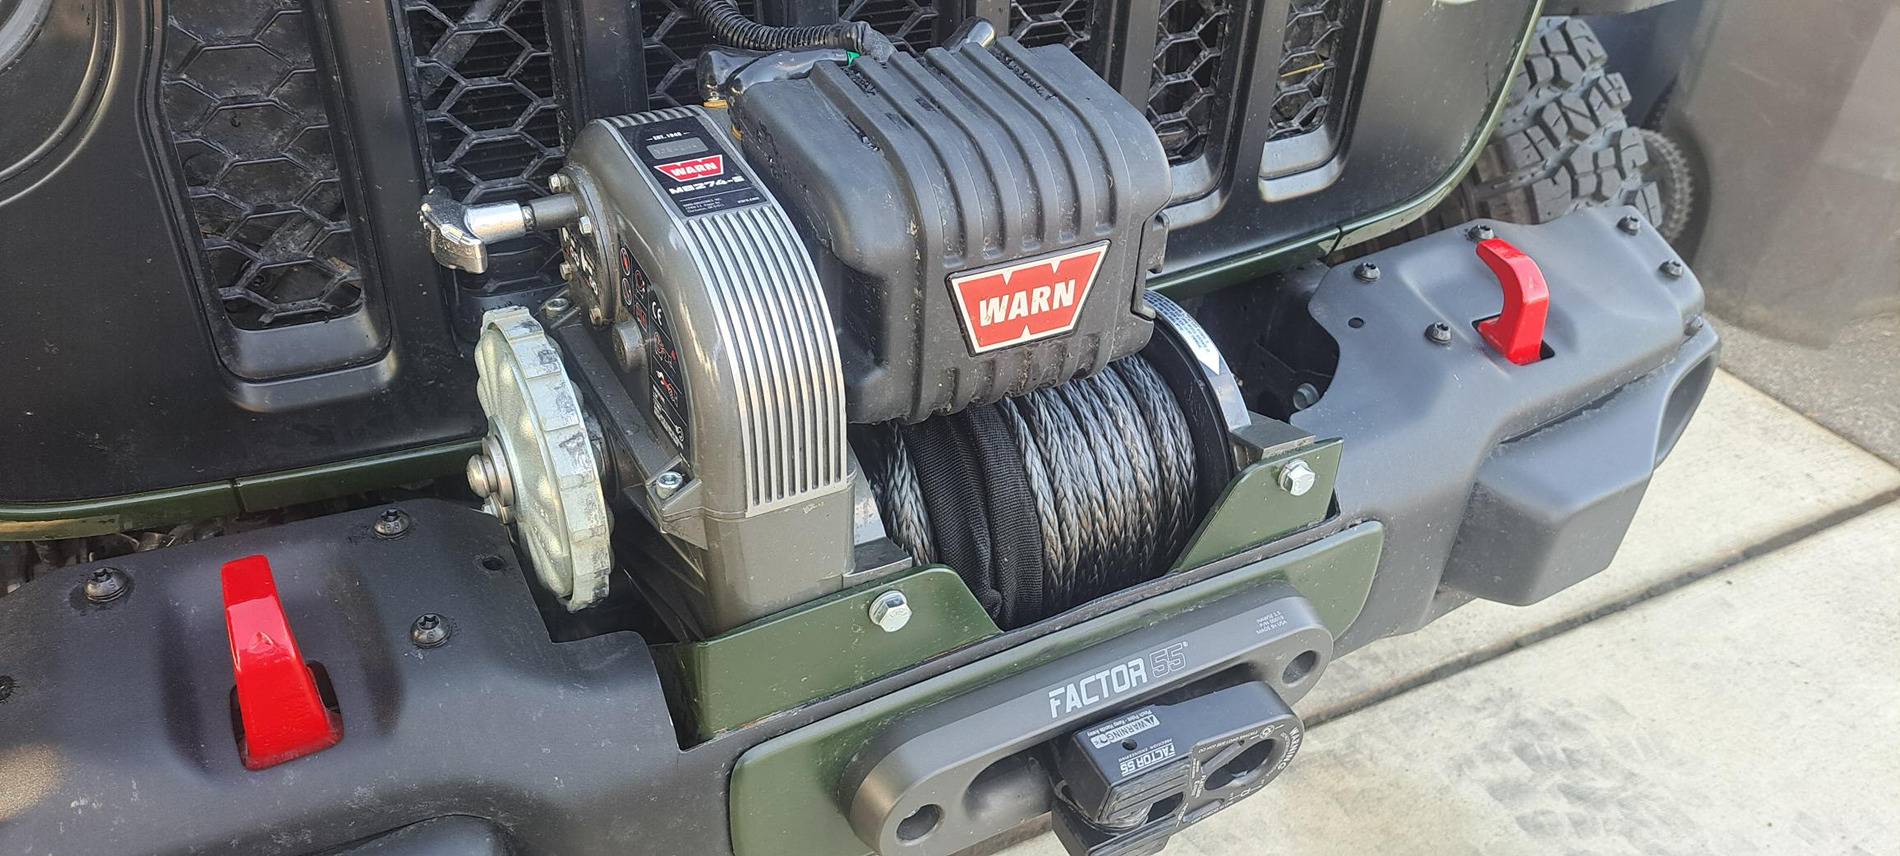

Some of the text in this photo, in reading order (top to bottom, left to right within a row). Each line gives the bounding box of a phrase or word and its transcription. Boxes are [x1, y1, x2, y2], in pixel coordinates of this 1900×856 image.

[670, 162, 718, 177] WARN
[978, 279, 1076, 327] WARN
[1048, 642, 1187, 719] FACTOR 55
[1105, 718, 1147, 742] WARNING
[1277, 727, 1300, 770] WARNING
[1119, 744, 1176, 775] FACTOR 55
